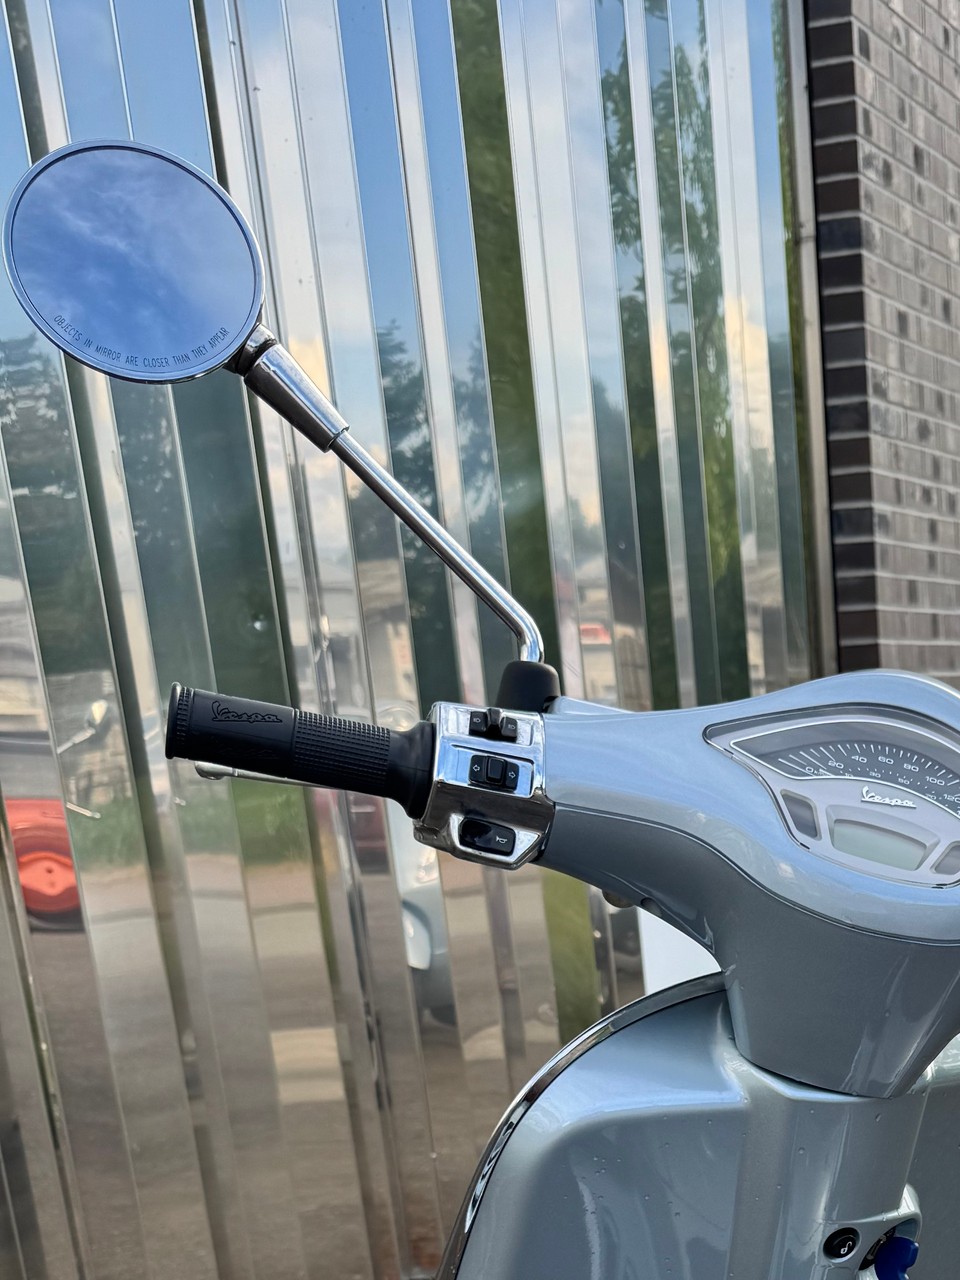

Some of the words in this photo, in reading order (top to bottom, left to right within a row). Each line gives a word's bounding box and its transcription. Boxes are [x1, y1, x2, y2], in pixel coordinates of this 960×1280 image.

[54, 315, 82, 342] OBJECTS
[84, 338, 92, 348] IN
[94, 345, 121, 362] MIRROR
[125, 355, 138, 366] ARE
[143, 358, 170, 368] CLOSER
[172, 353, 191, 365] THAN
[191, 346, 208, 360] THEY
[208, 326, 230, 350] APPEAR
[211, 700, 283, 723] Vespa
[851, 754, 867, 764] 40
[878, 756, 894, 765] 60
[828, 760, 844, 769] 20
[903, 763, 920, 772] 80
[925, 775, 945, 786] 100
[860, 785, 917, 809] Vespa
